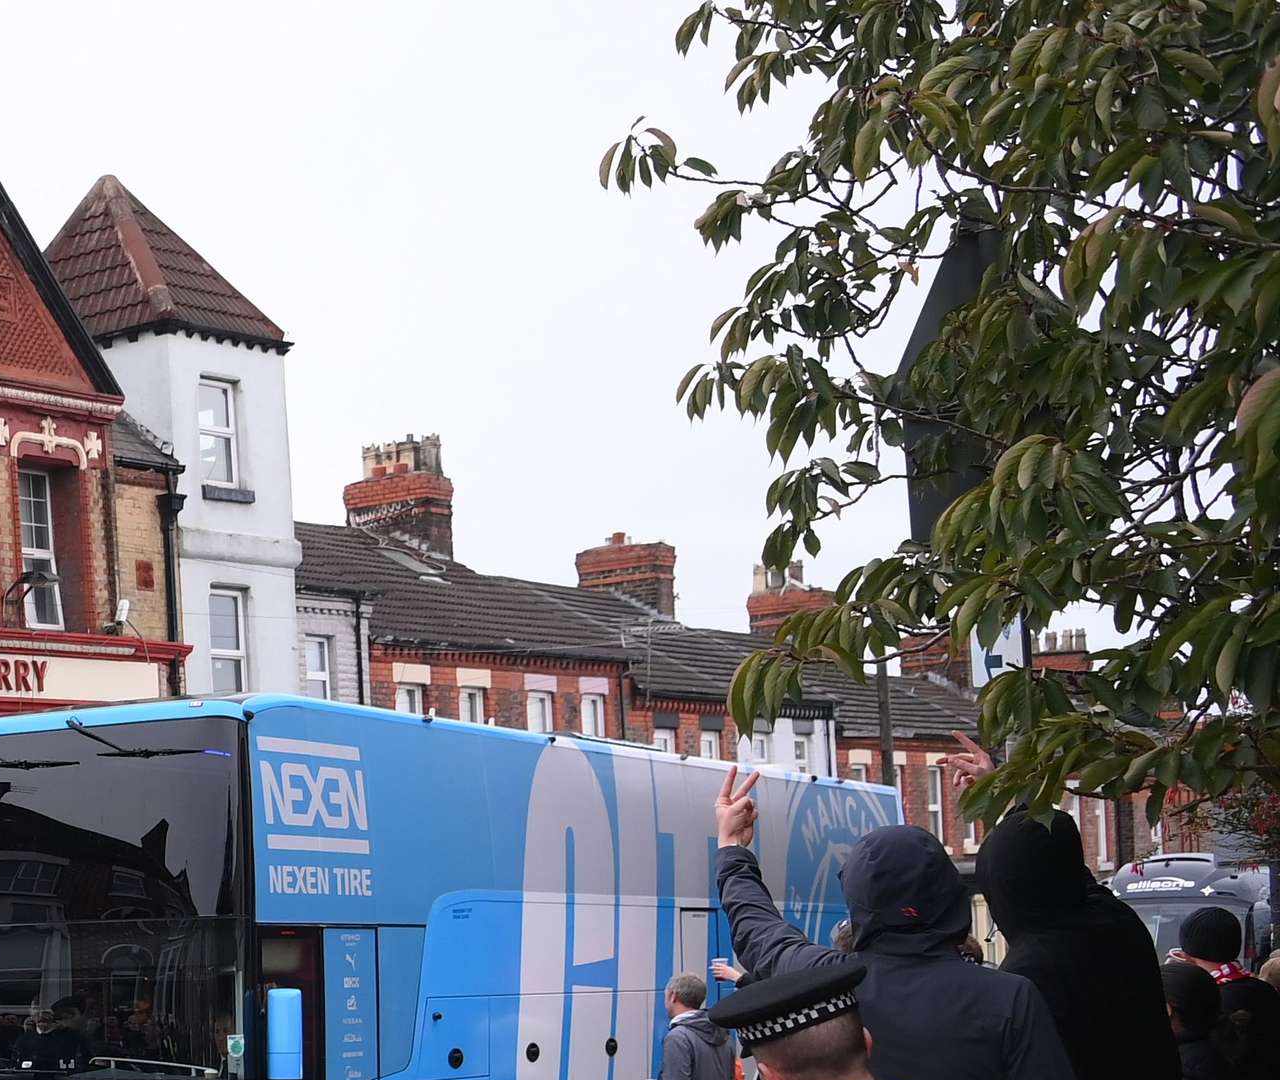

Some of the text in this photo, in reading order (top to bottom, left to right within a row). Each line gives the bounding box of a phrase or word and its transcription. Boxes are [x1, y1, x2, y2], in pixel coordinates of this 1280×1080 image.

[259, 760, 368, 831] NEXEN
[268, 865, 373, 896] NEXEN TIRE
